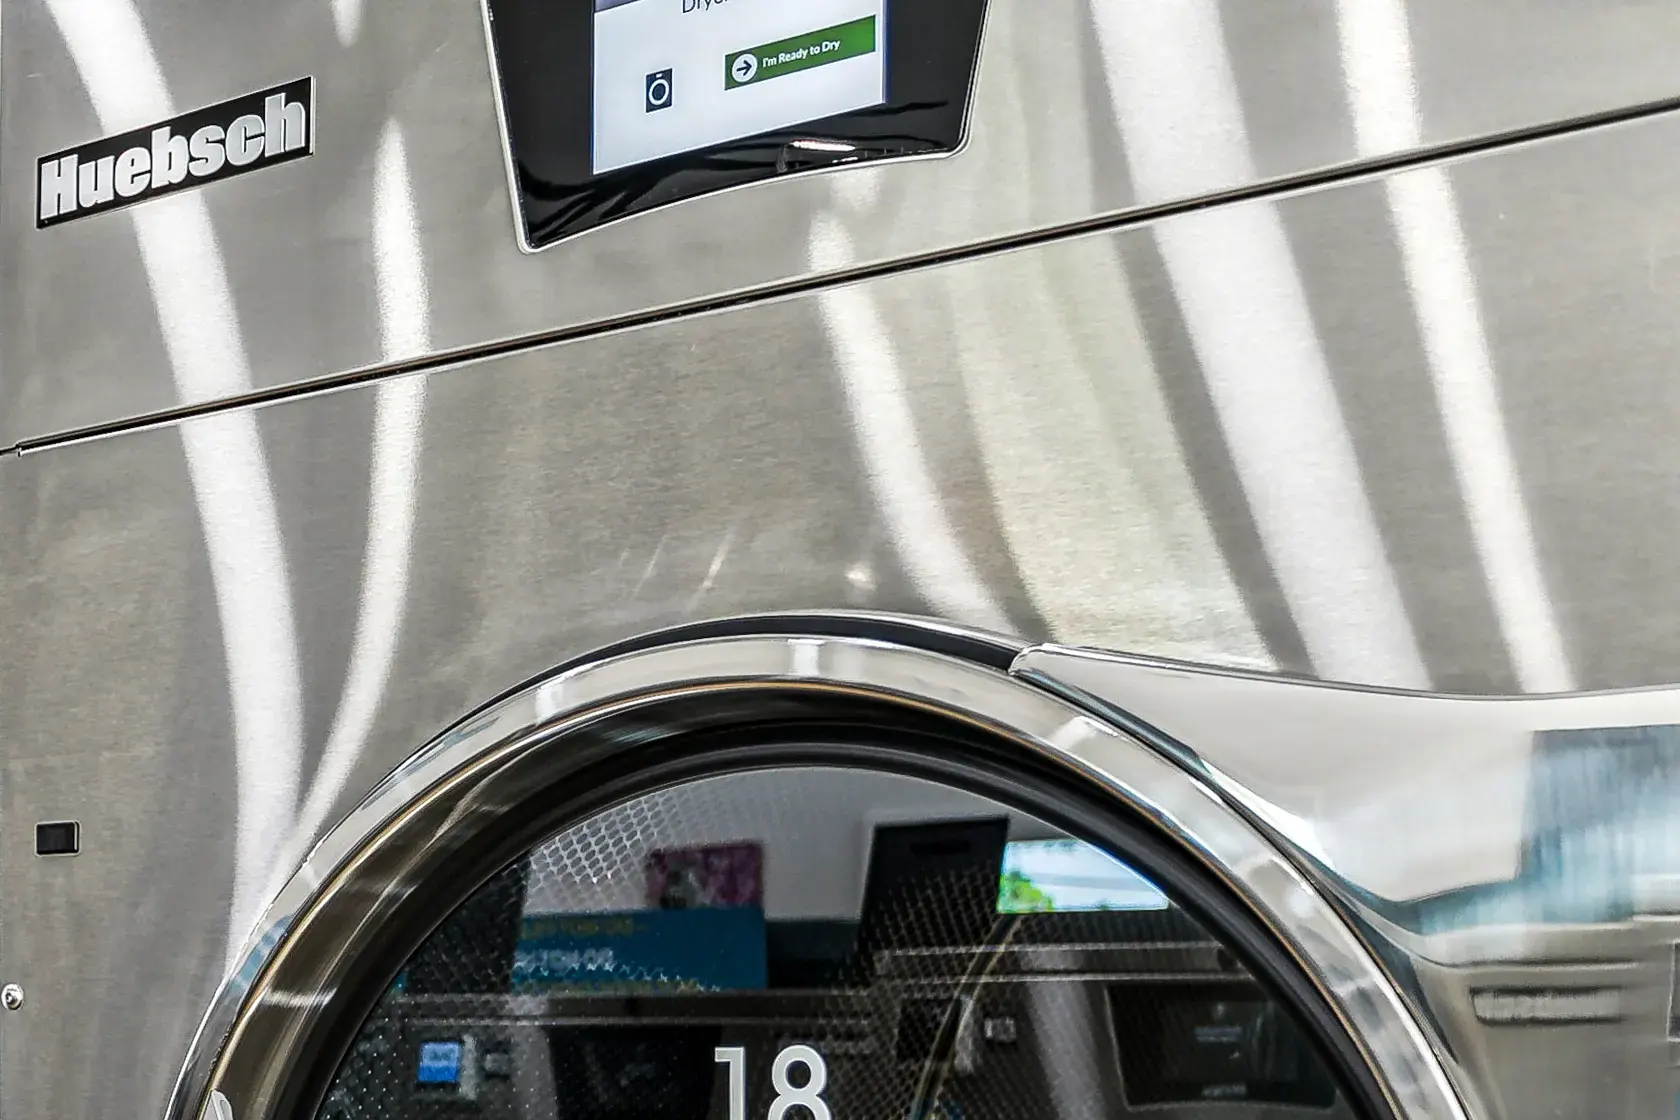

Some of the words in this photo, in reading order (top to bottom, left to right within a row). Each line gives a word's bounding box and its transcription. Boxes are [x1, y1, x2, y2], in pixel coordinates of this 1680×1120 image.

[682, 0, 727, 13] Dry
[762, 57, 777, 68] I'm
[778, 48, 808, 64] Ready
[810, 45, 820, 55] to
[821, 40, 840, 53] Dry
[40, 92, 306, 220] Huebsch
